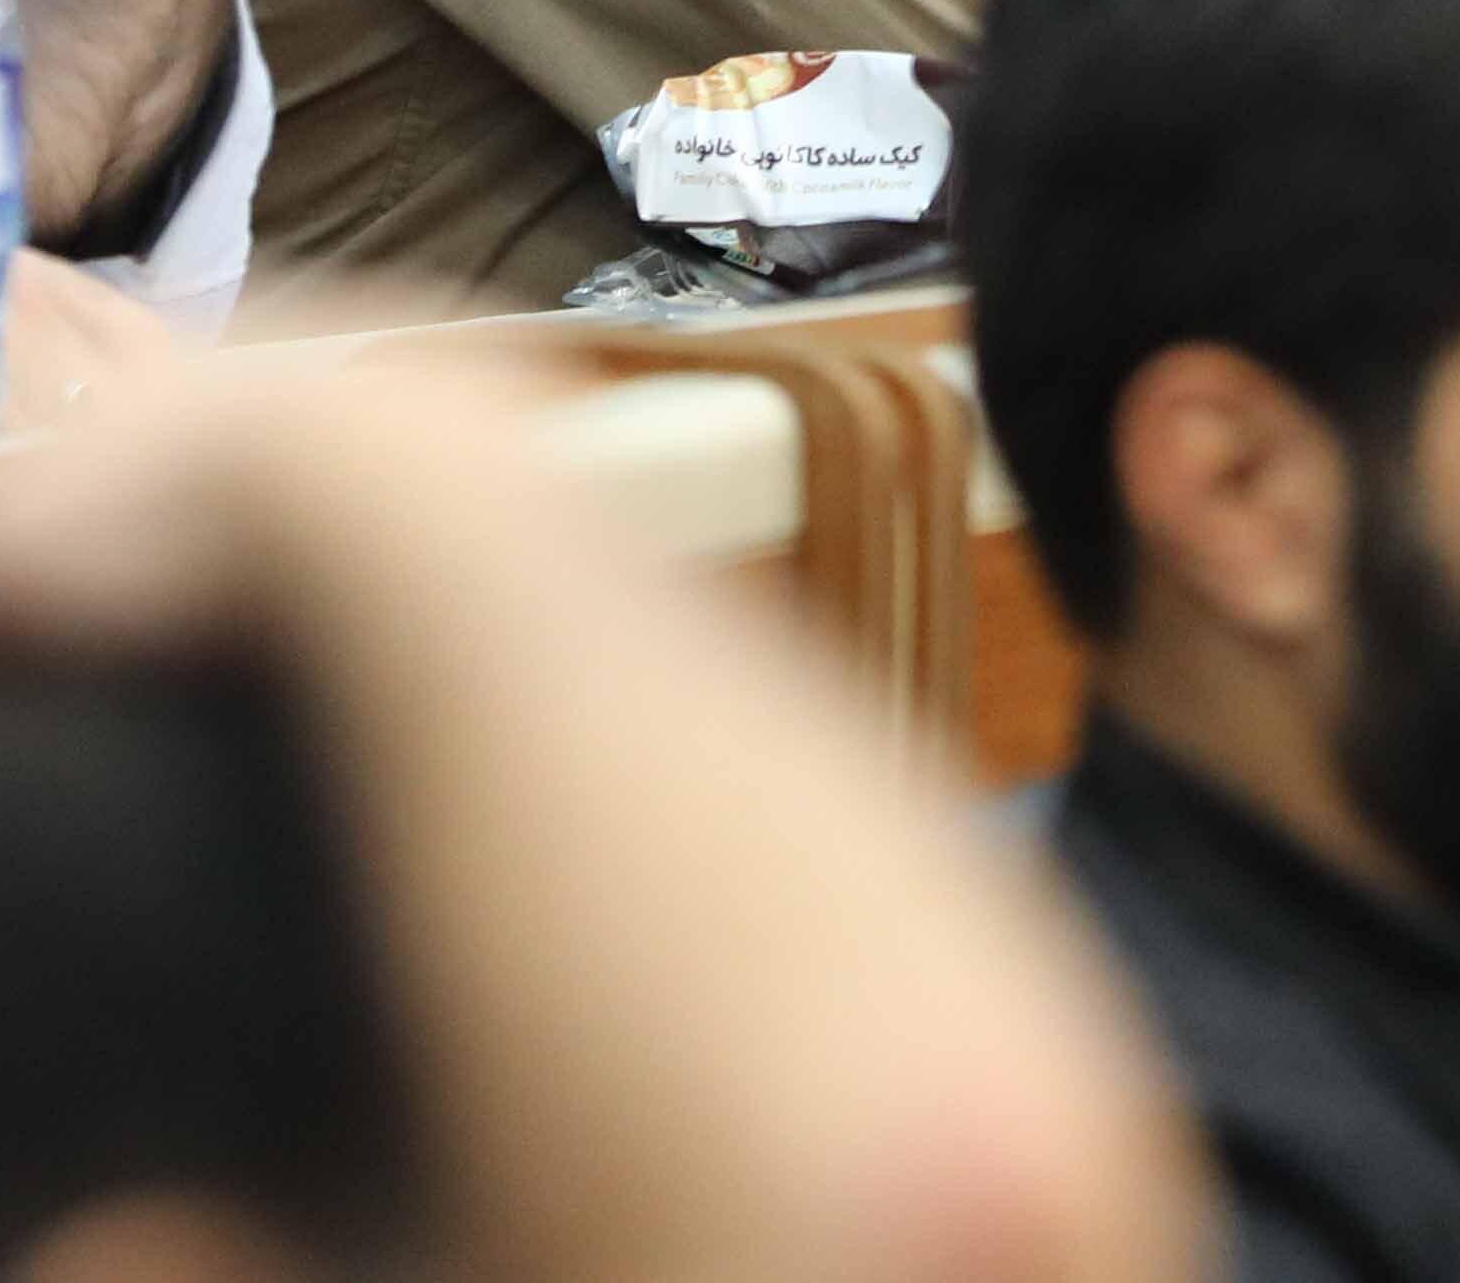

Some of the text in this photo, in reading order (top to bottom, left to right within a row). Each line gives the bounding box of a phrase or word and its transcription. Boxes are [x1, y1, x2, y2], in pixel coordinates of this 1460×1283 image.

[674, 135, 737, 164] خانواده
[826, 146, 876, 167] ساده
[879, 143, 924, 171] کیک
